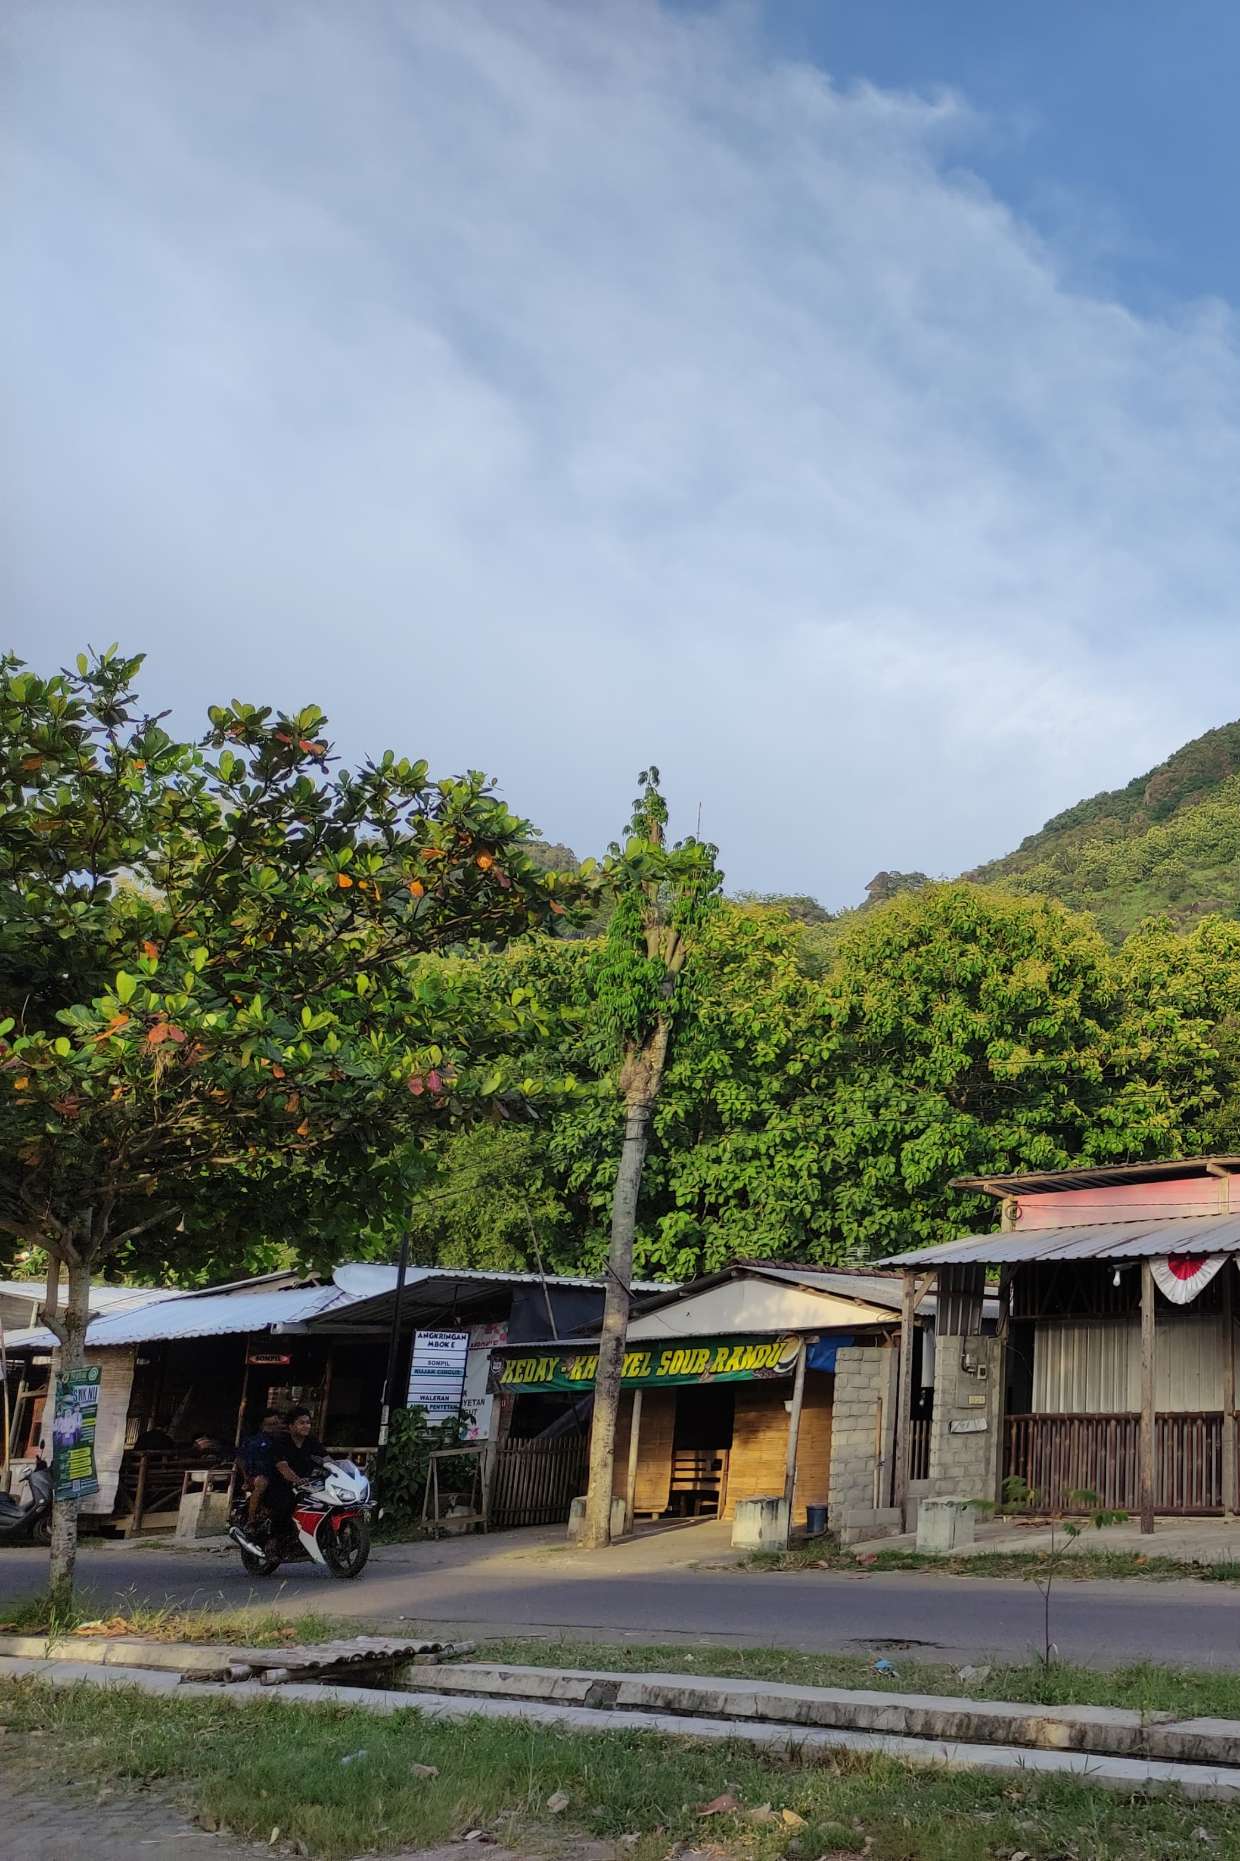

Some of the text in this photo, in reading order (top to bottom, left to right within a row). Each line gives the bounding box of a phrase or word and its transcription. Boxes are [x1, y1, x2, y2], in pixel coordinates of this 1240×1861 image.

[417, 1332, 467, 1340] ANGKRINGAN
[500, 1357, 560, 1384] KEDAY
[656, 1349, 710, 1376] SOUR
[710, 1343, 787, 1373] RANDU
[463, 1399, 486, 1407] YETAN
